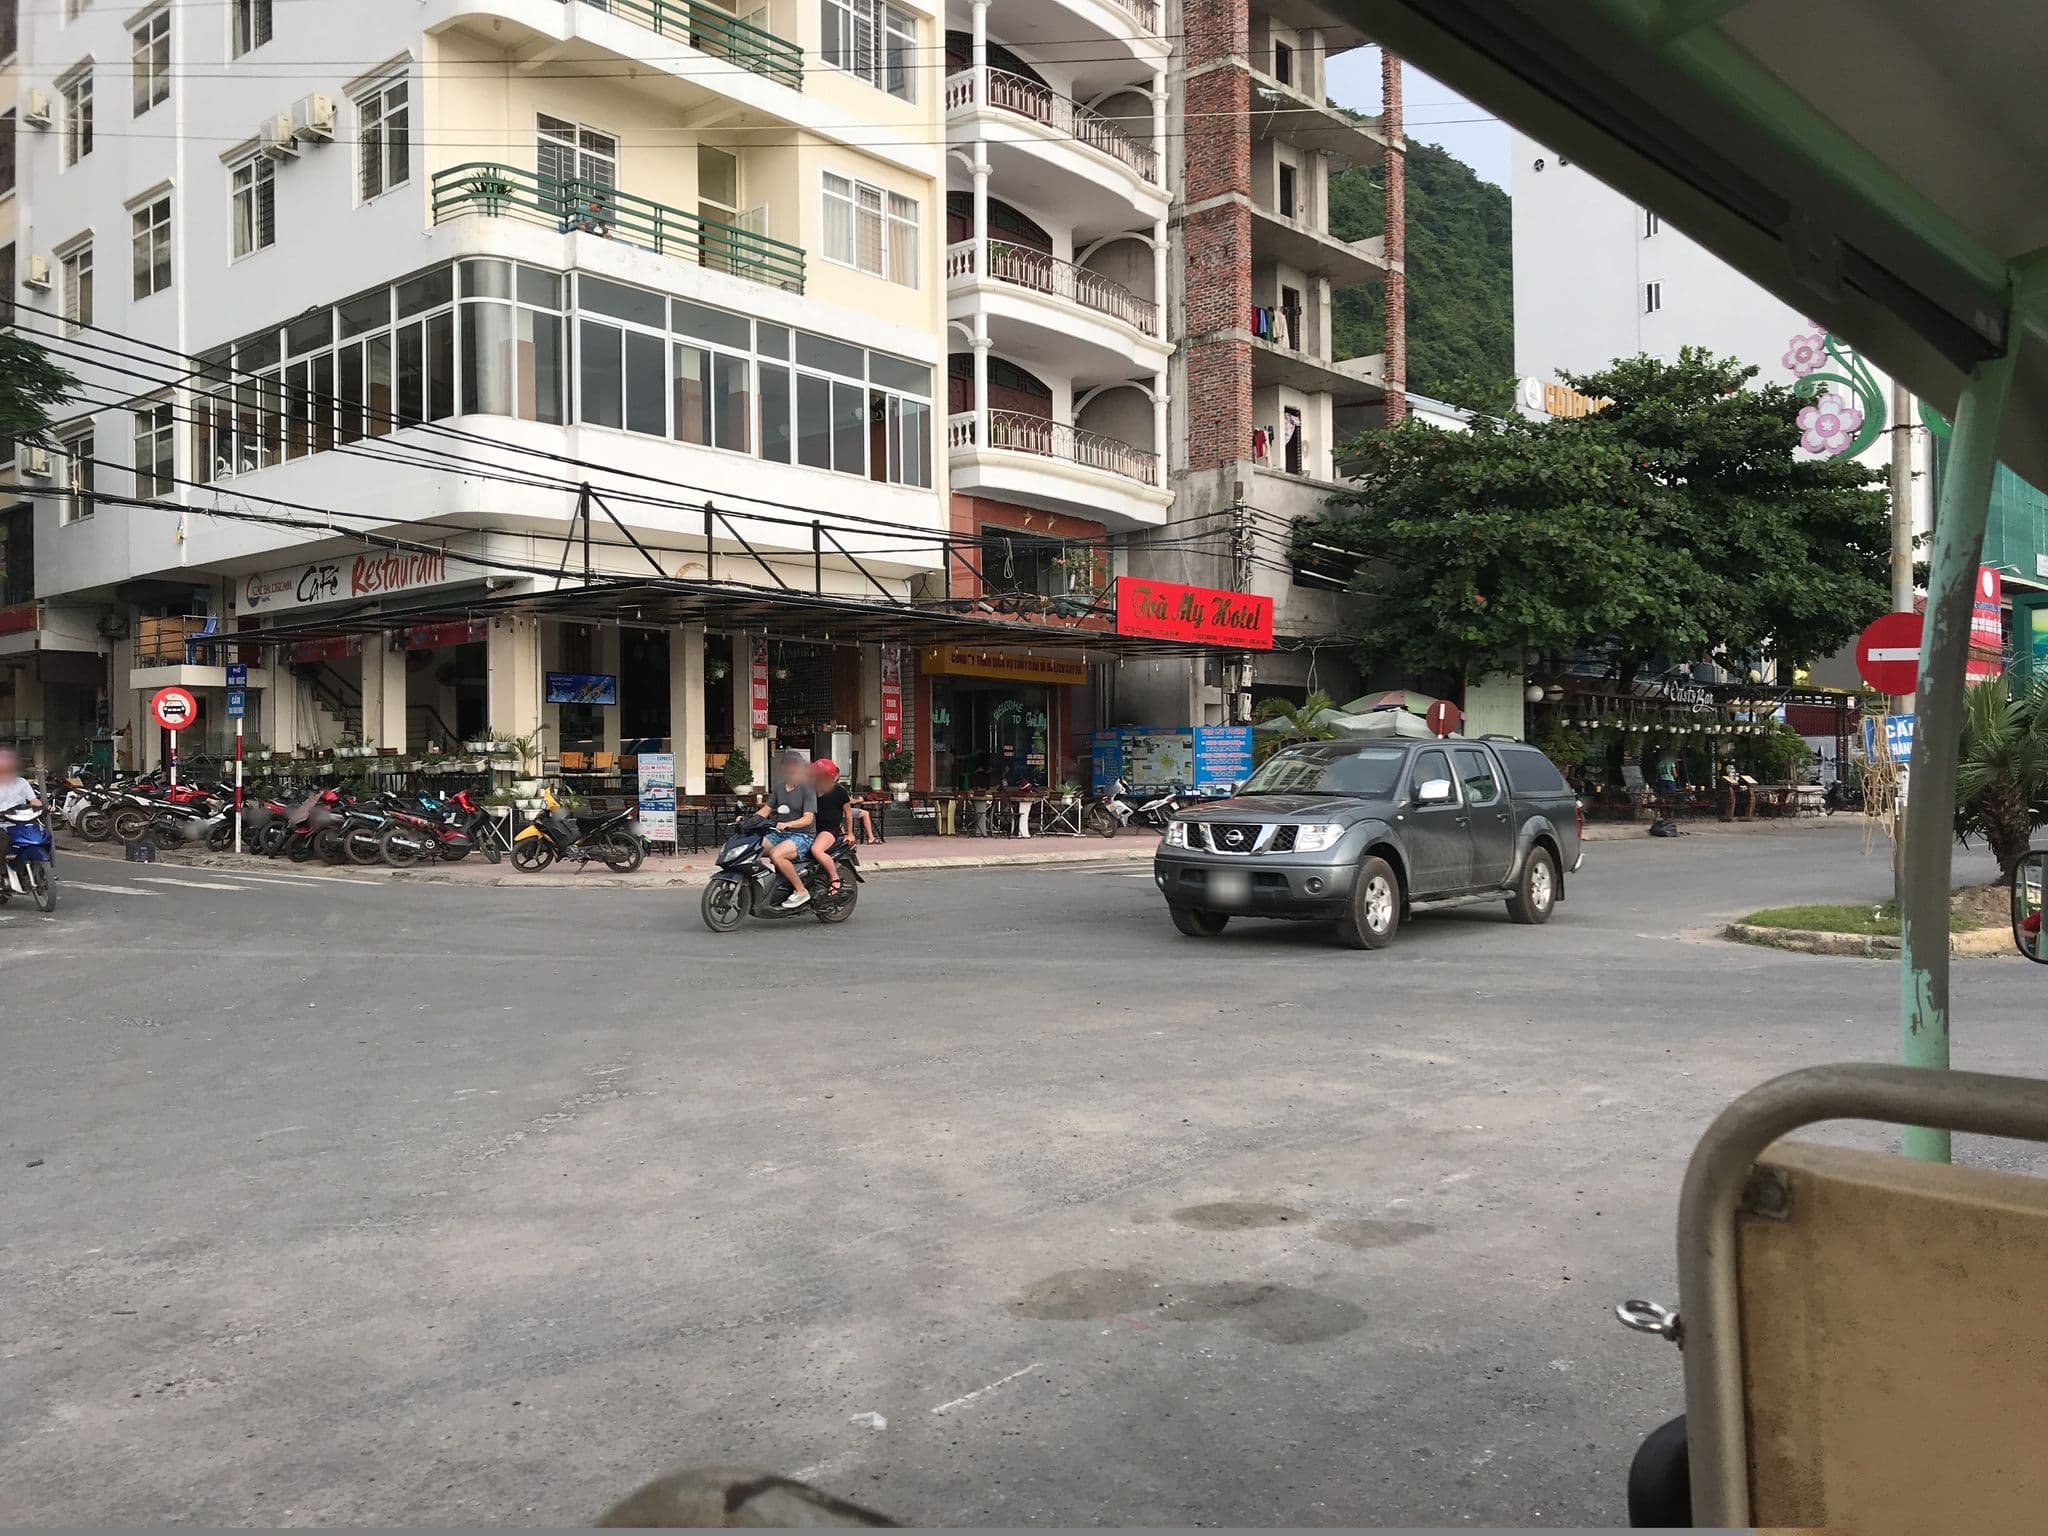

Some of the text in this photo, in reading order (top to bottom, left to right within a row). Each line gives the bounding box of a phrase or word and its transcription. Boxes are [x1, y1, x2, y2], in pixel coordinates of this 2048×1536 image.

[351, 550, 446, 597] Restaurant
[1132, 586, 1261, 631] Trà My Hotel
[993, 699, 1023, 721] WELCOME
[1012, 714, 1021, 725] TO
